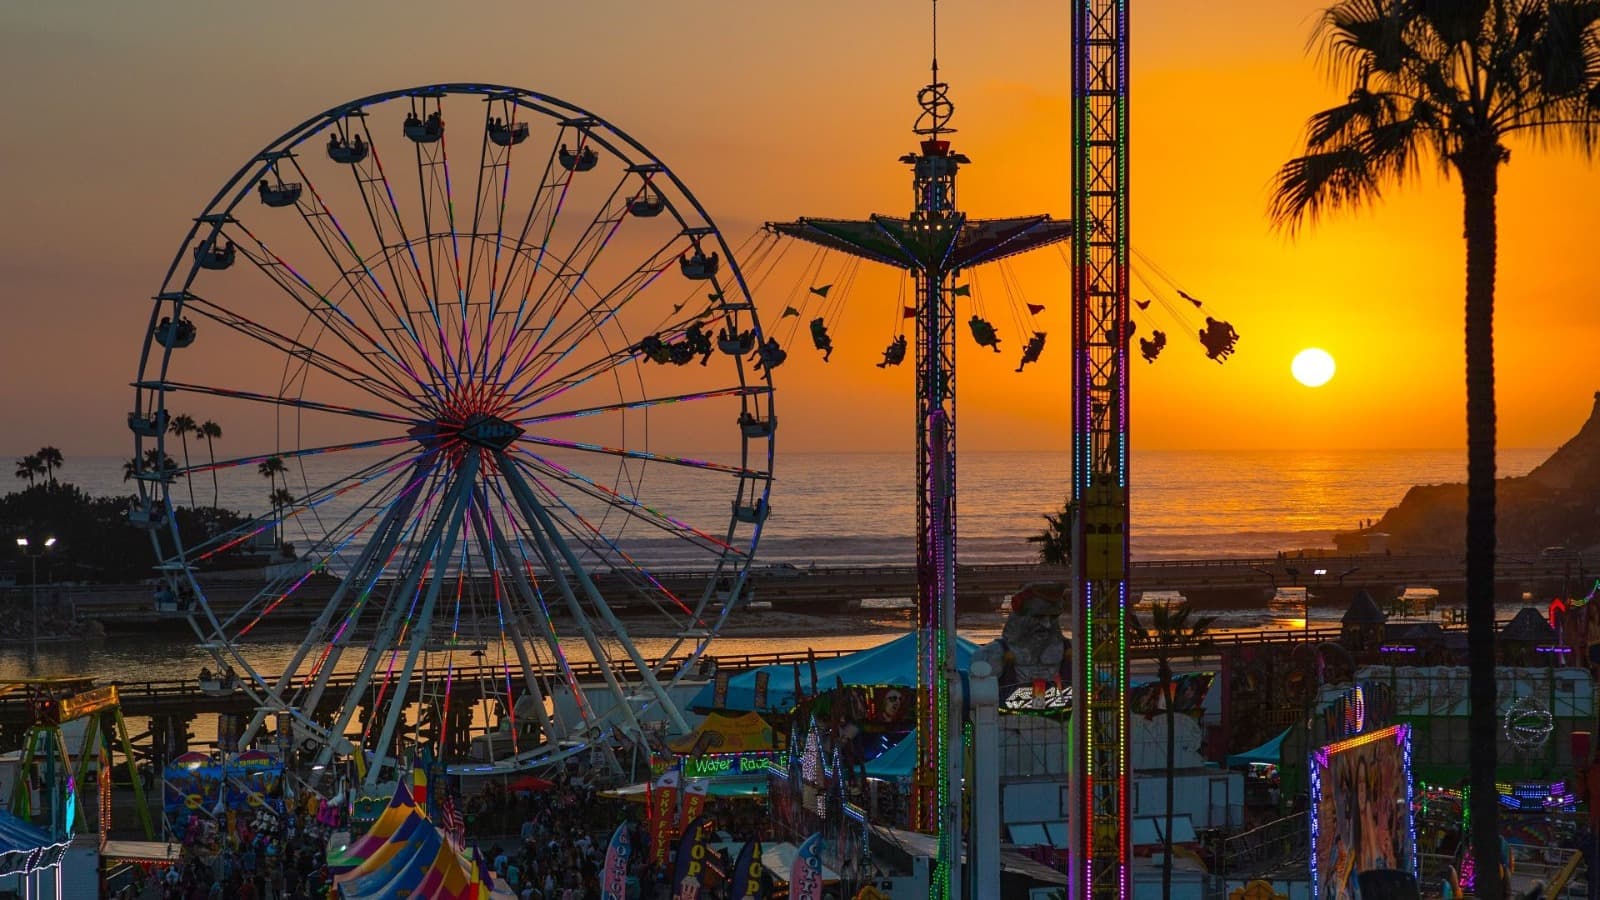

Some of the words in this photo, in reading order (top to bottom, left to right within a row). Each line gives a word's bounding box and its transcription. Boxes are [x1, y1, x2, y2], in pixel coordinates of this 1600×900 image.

[696, 759, 734, 773] Water
[741, 757, 770, 772] Race
[660, 789, 671, 817] SKY
